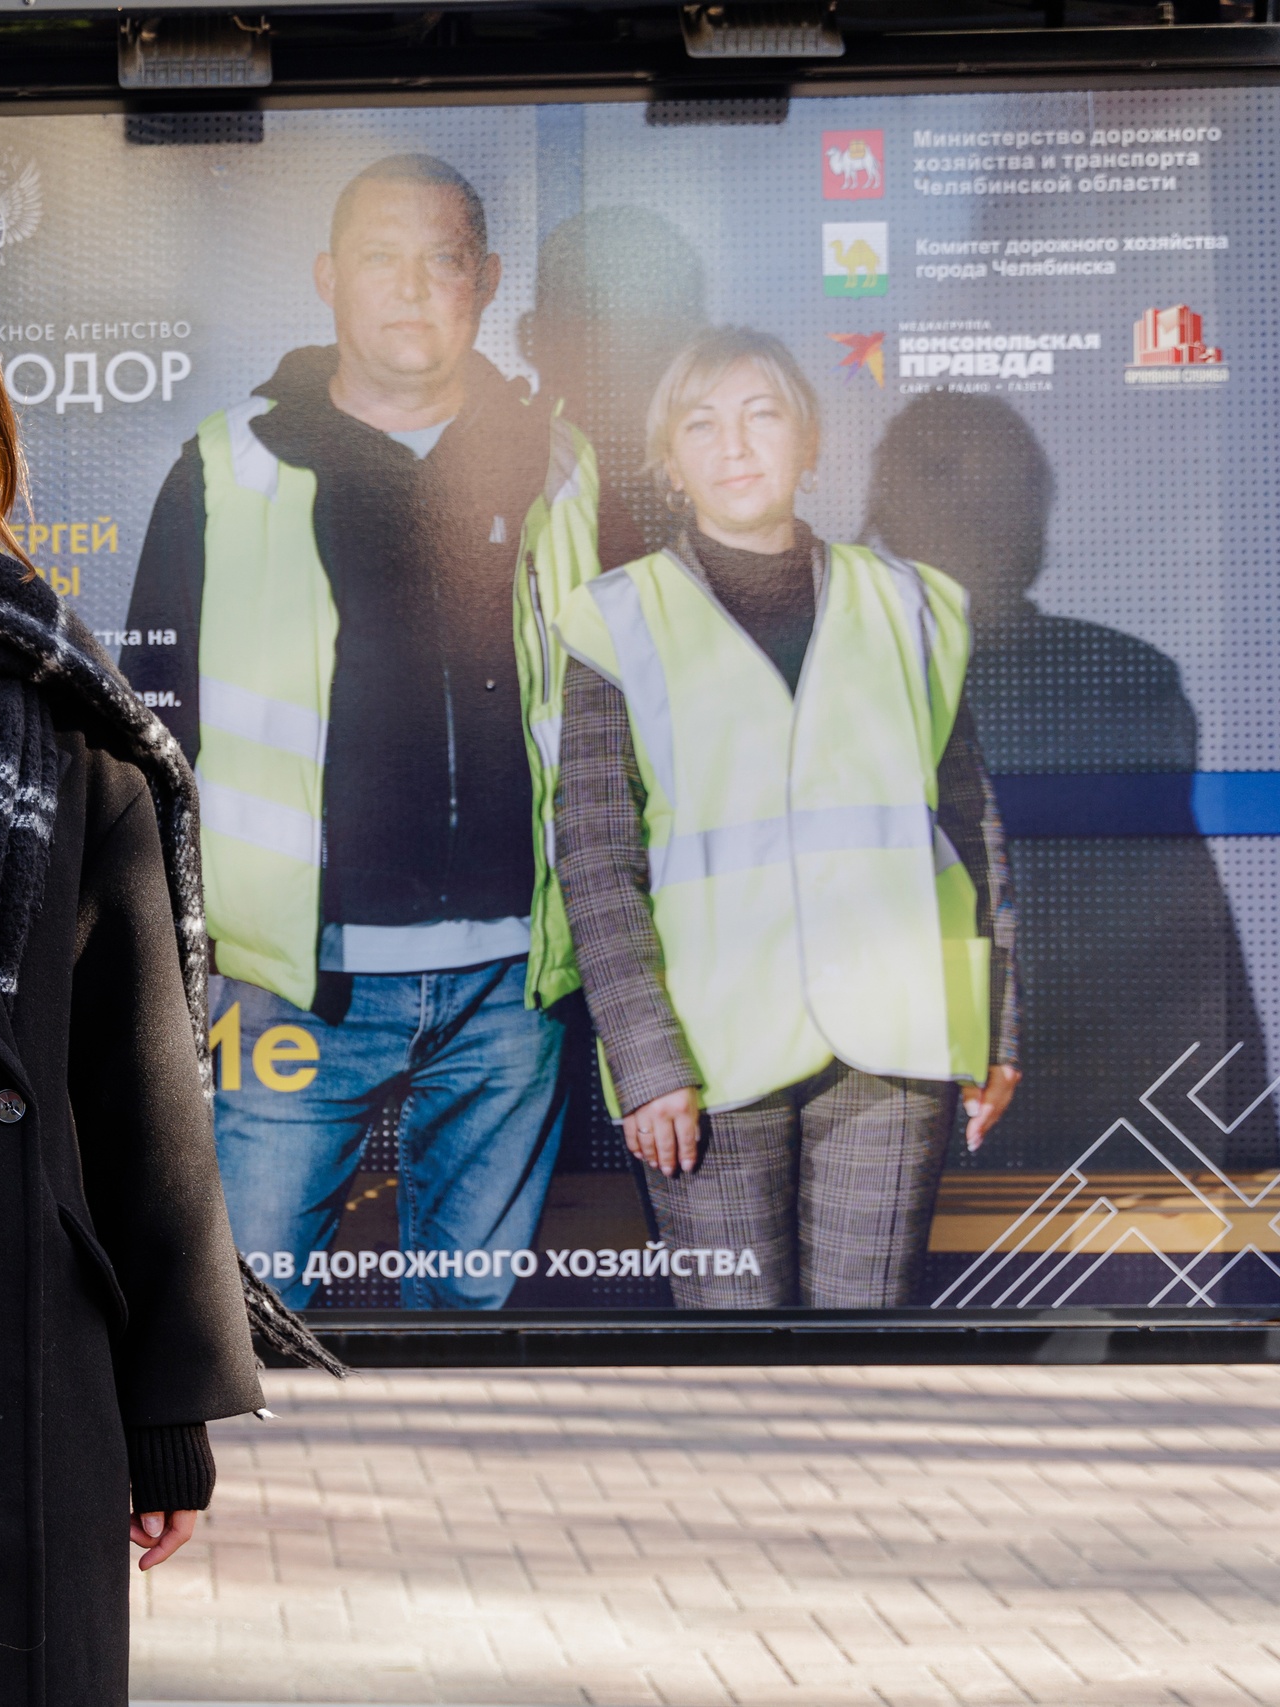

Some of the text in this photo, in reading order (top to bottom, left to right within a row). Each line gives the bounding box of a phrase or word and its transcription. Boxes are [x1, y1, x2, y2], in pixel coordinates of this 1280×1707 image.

[913, 127, 1223, 149] Министерство дорожного
[913, 151, 1200, 172] хозяйства и транспорта
[913, 173, 1177, 196] Челябинской области
[916, 232, 1229, 257] Комитет дорожного хозяйства
[916, 258, 1117, 282] города Челябинска
[64, 321, 192, 341] АГЕНТСТВО
[898, 319, 991, 332] МЕДИАГРУППА
[899, 333, 1102, 353] КОМСОМОЛЬСКАЯ
[899, 351, 1054, 379] ПРАВДА
[1008, 380, 1054, 392] ГАЗЕТА
[147, 628, 177, 646] на
[239, 1240, 761, 1286] ОВ ДОРОЖНОГО ХОЗЯЙСТВА
